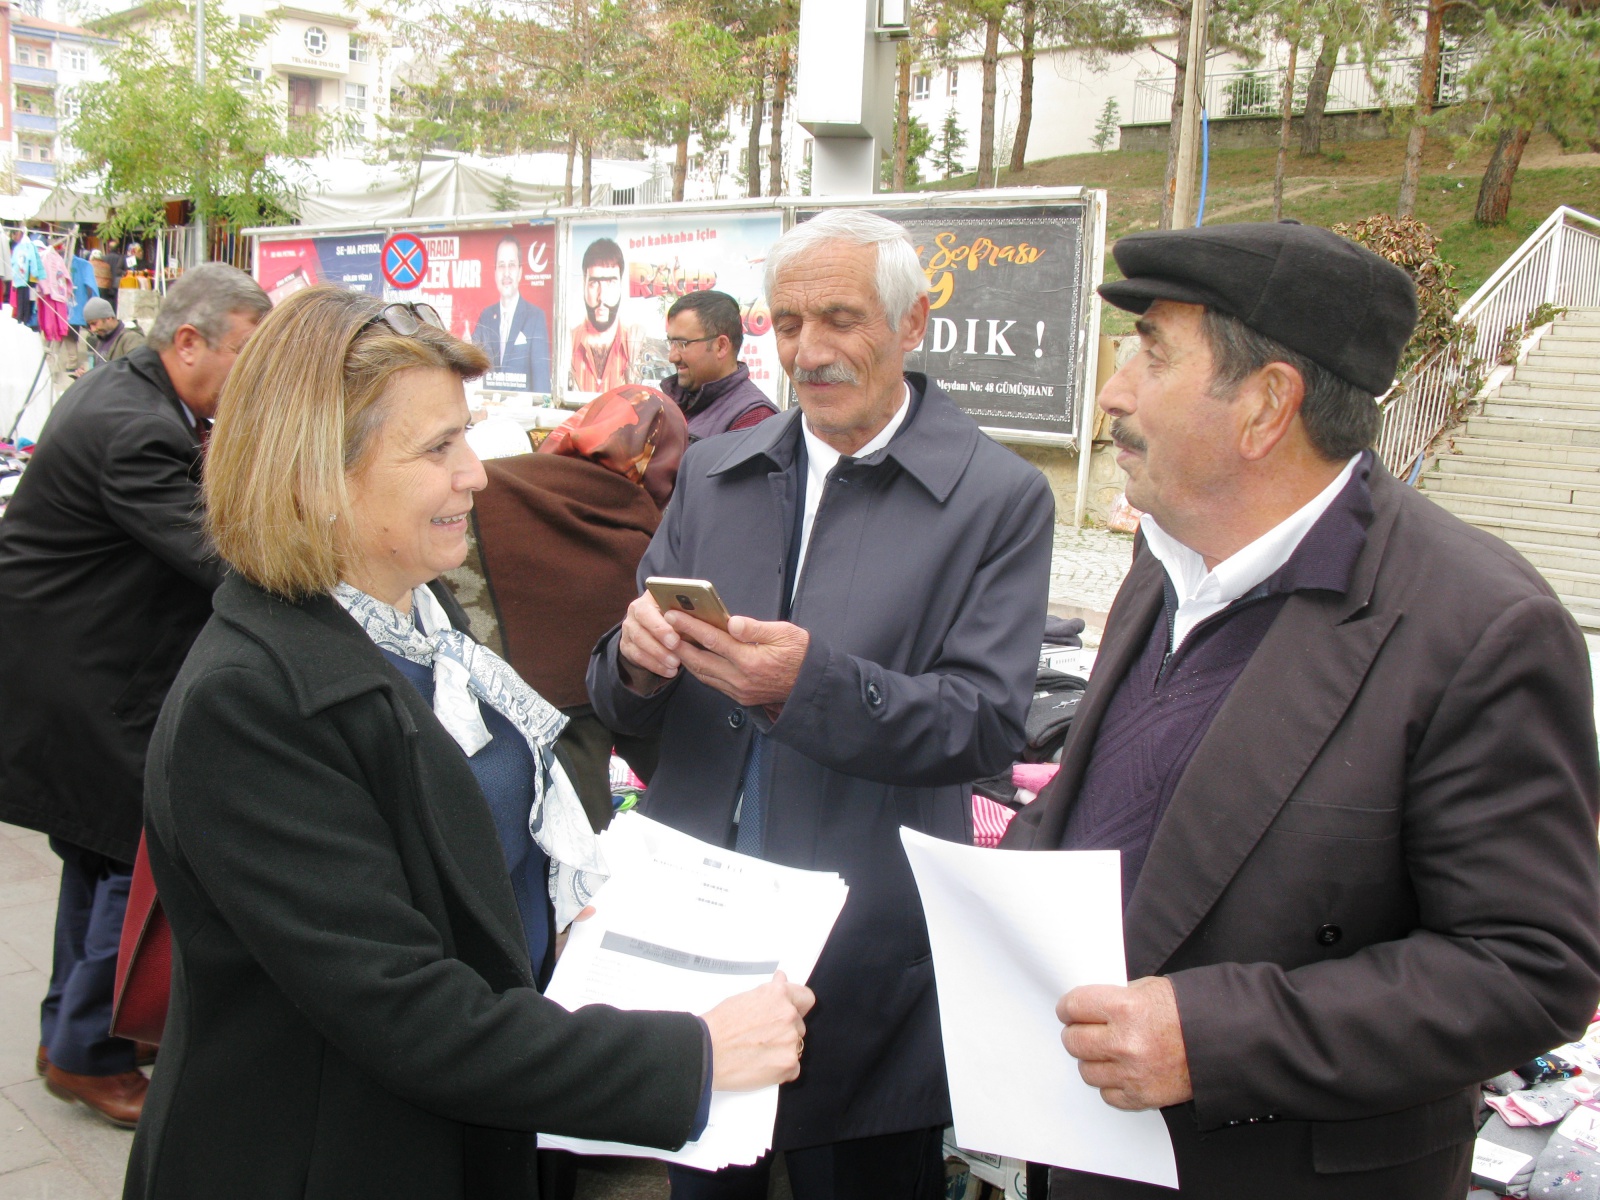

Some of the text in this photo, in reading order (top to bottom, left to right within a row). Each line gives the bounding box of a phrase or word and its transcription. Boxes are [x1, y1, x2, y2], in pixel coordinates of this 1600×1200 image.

[336, 243, 382, 256] SE-MA PETROL
[629, 228, 717, 249] bol kahkaha için
[929, 231, 1046, 272] Sofrası
[451, 259, 481, 288] VAR
[629, 261, 718, 299] RECEP
[914, 317, 1017, 357] DIK
[969, 381, 983, 392] No:
[985, 382, 994, 393] 48
[995, 381, 1055, 398] GÜMÜŞHANE
